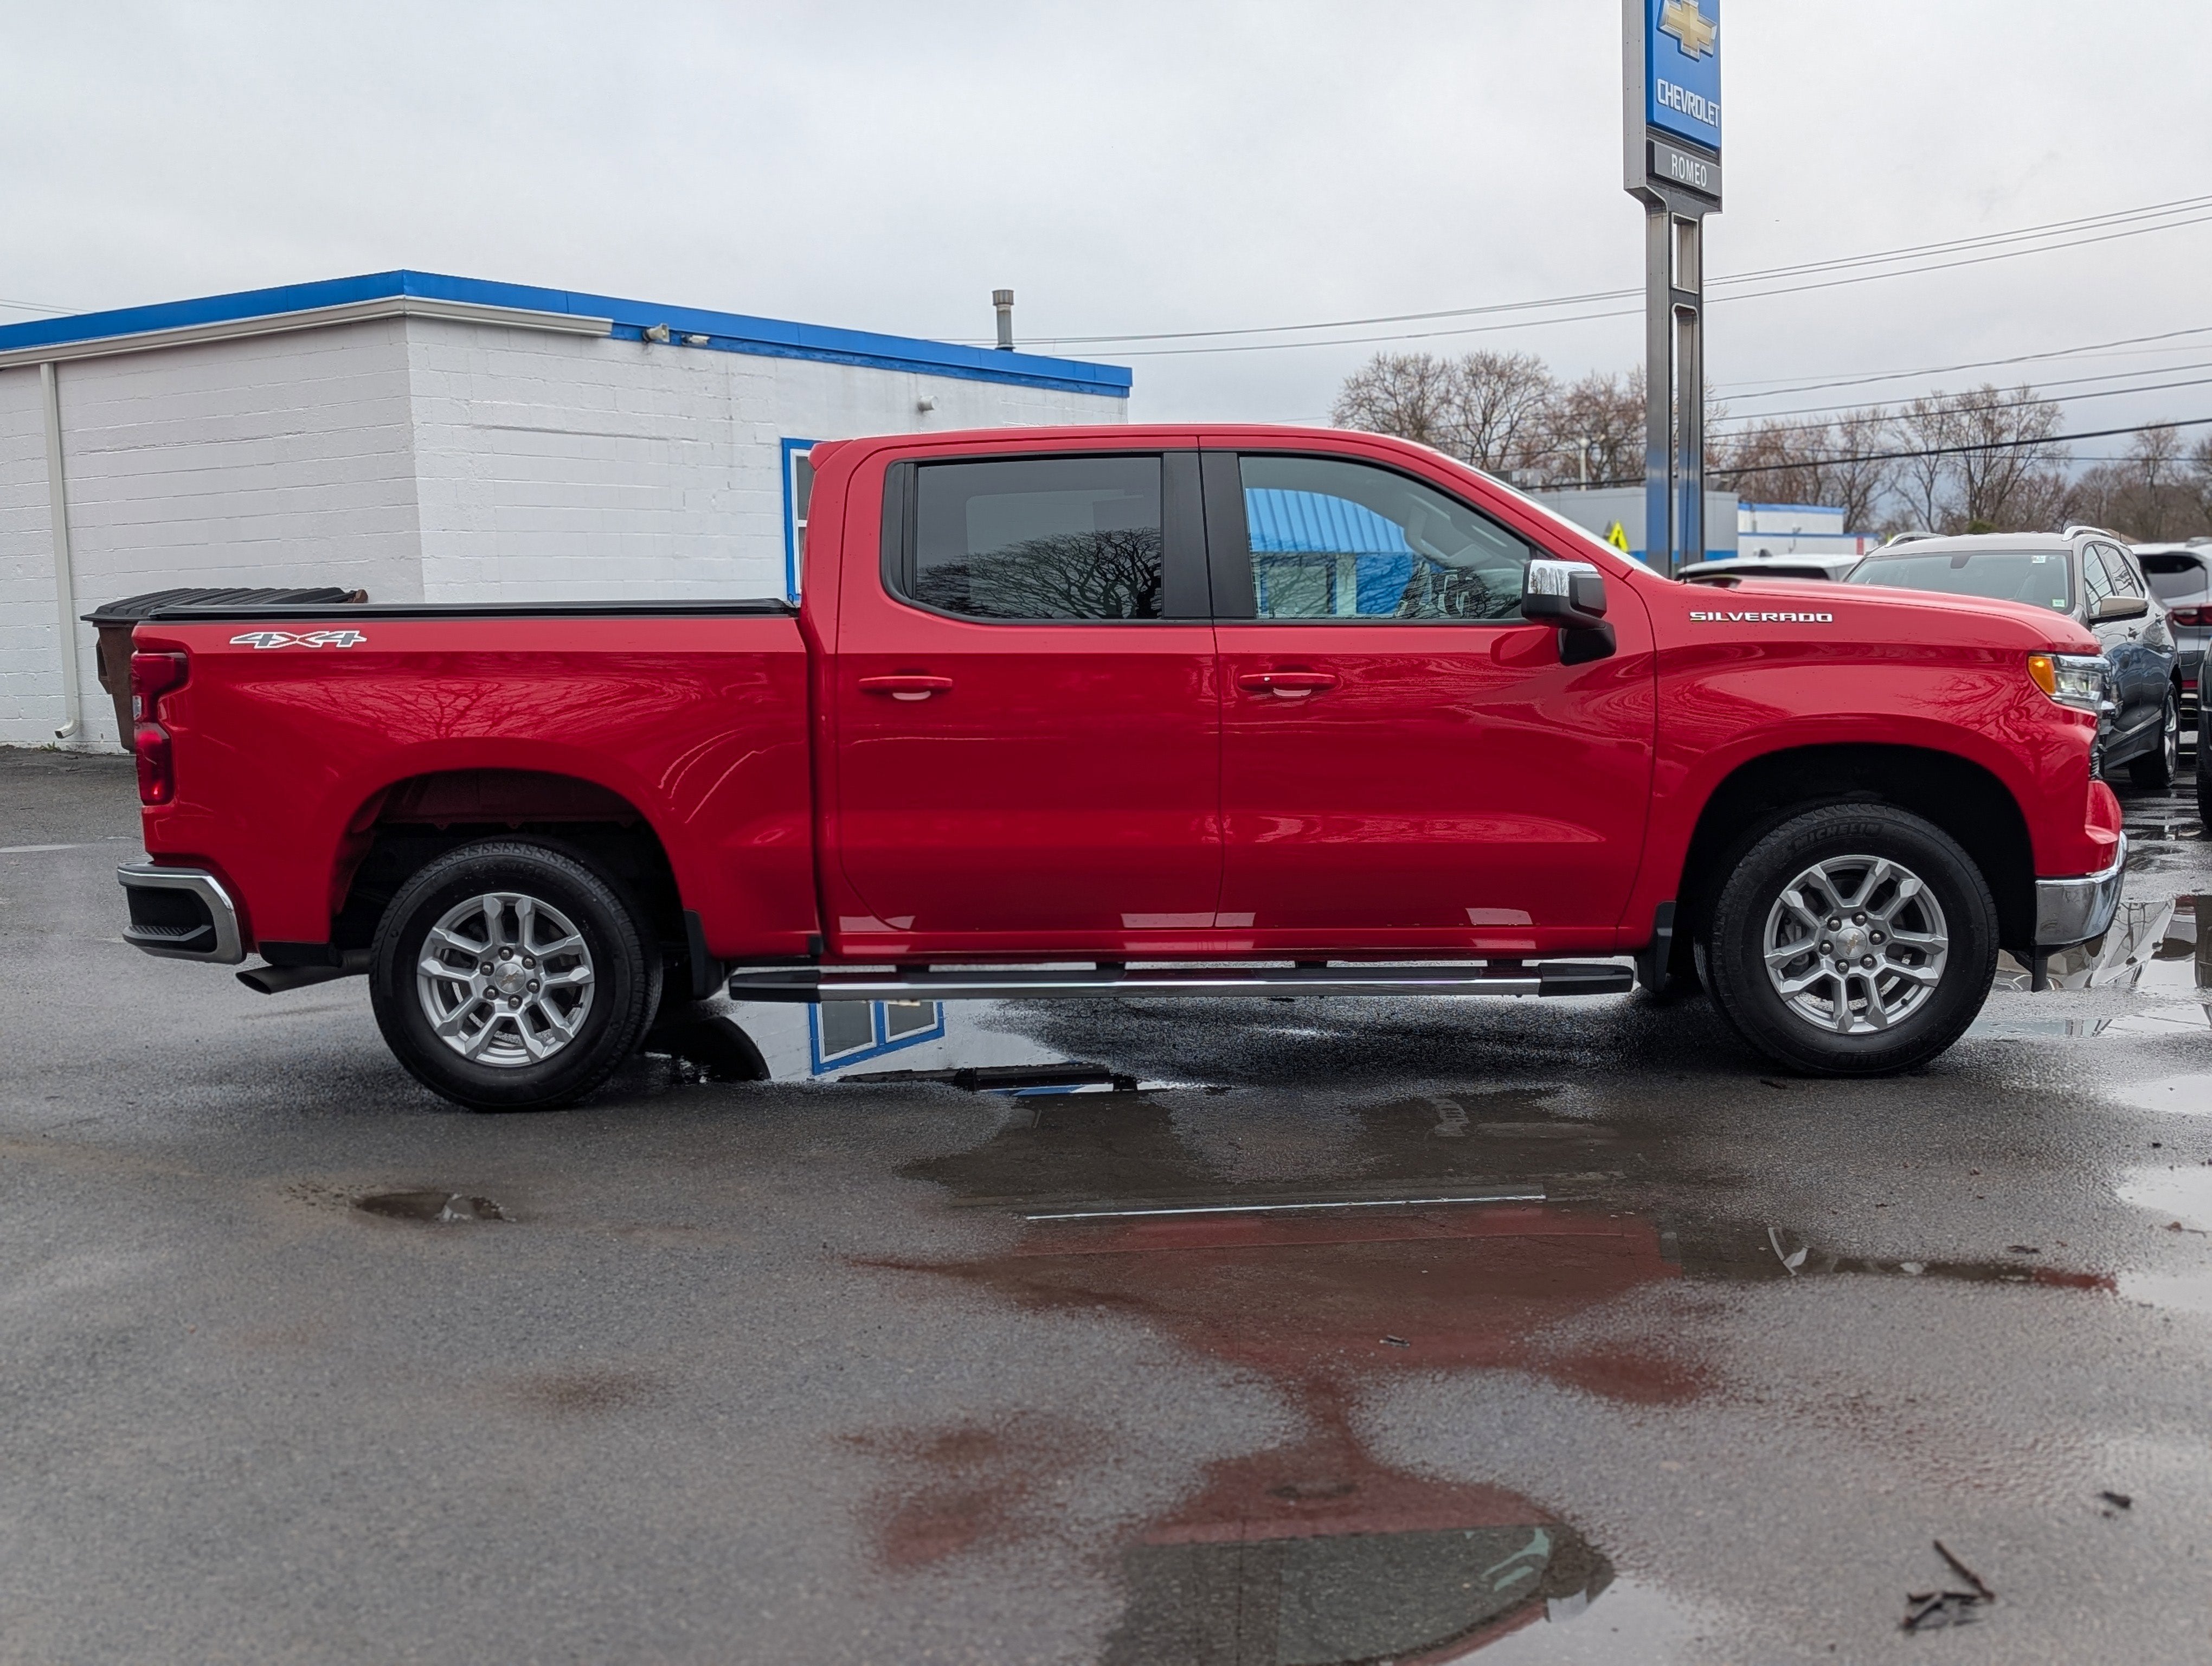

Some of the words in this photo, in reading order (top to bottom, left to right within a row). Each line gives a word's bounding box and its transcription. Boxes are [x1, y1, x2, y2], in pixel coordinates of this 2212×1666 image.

[1656, 79, 1719, 127] CHEVROLET
[1672, 153, 1707, 187] ROMEO
[1690, 611, 1833, 623] SILVERADO
[1795, 822, 1882, 849] MICHELIN
